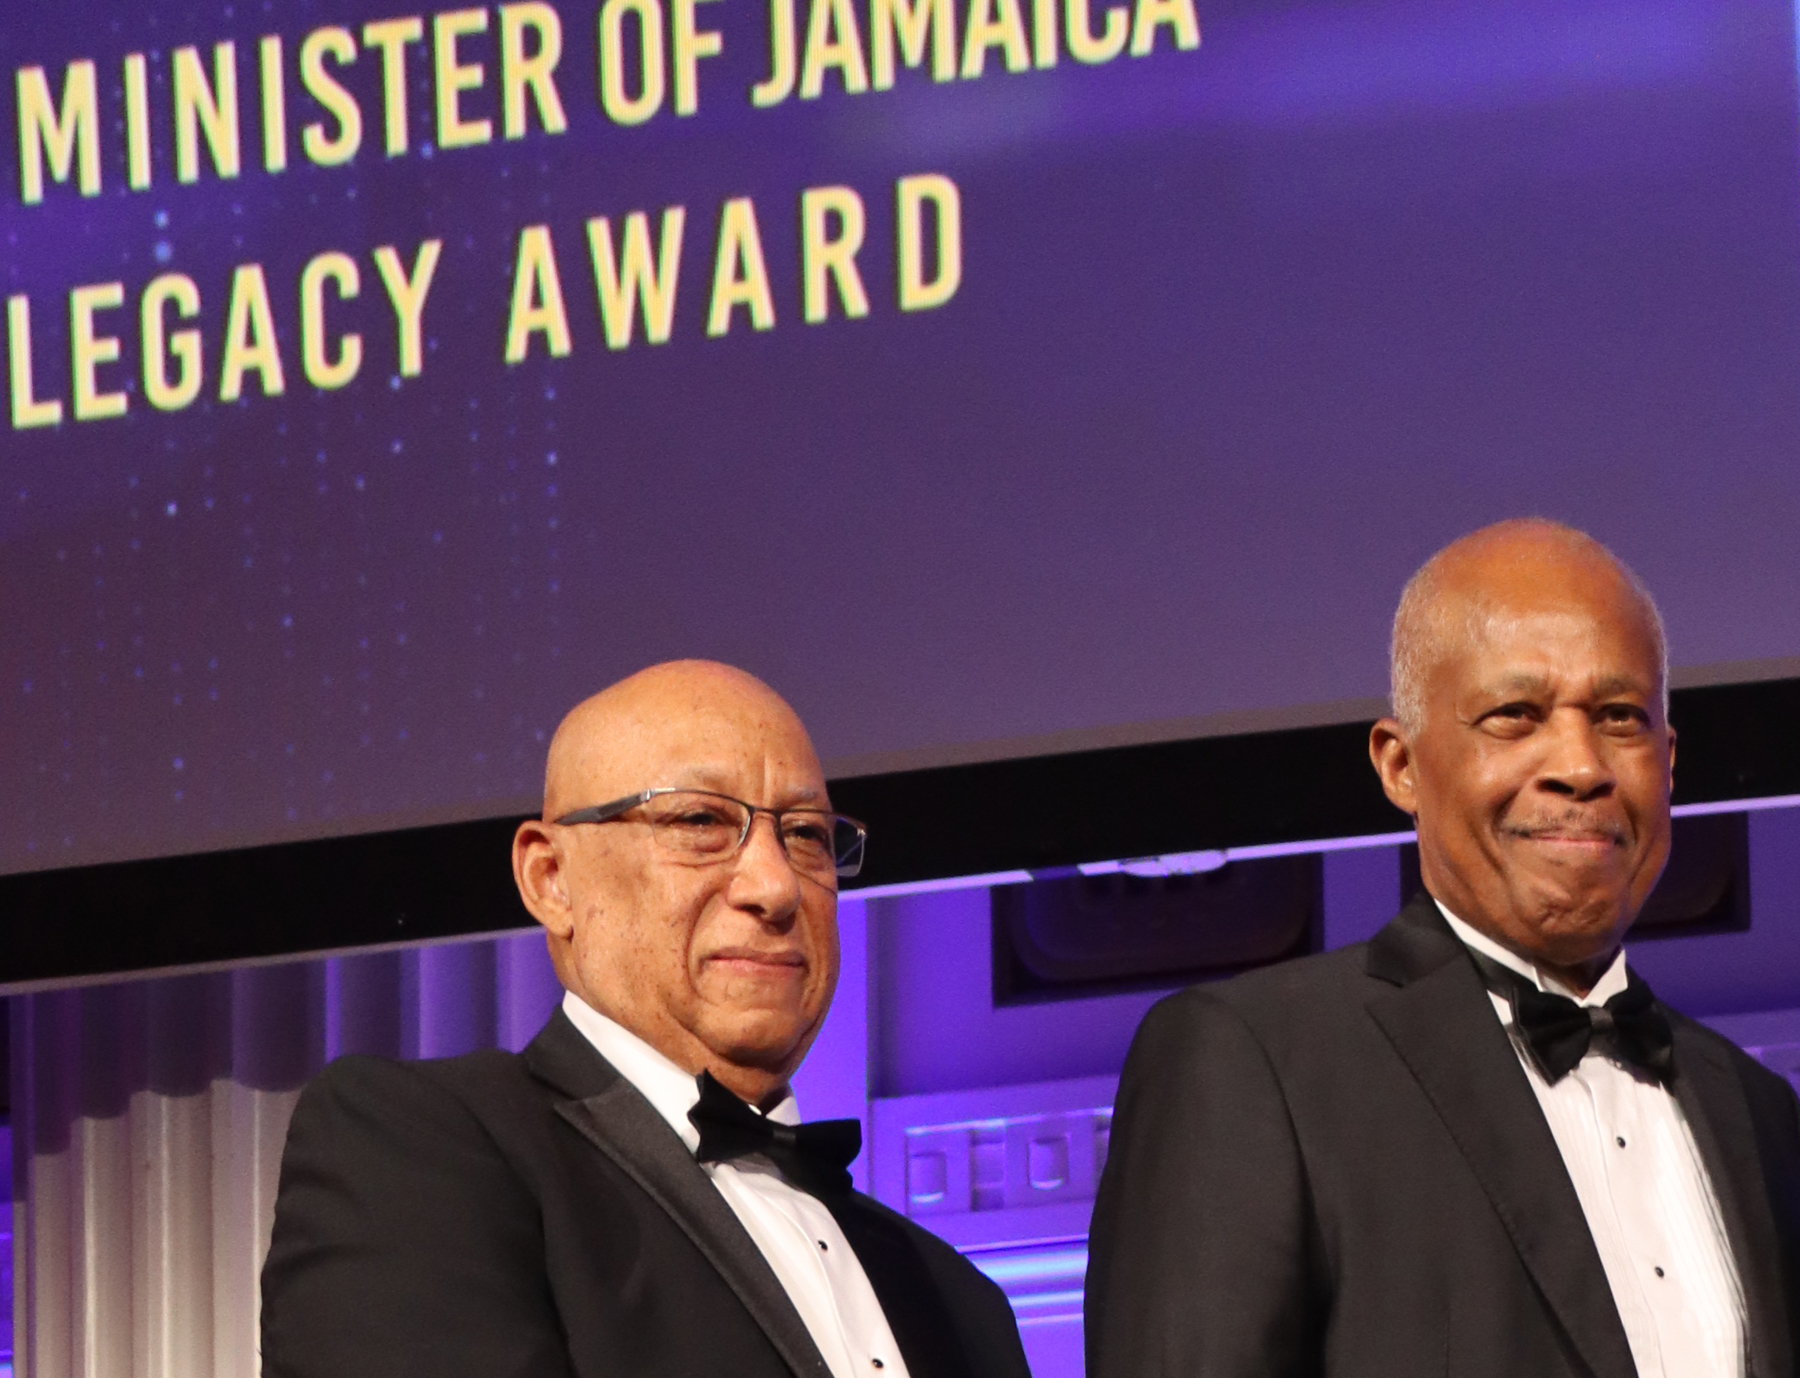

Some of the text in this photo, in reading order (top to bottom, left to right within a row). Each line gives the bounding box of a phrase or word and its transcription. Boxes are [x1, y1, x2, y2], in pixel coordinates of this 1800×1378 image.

[16, 2, 567, 203] MINISTER
[599, 0, 723, 126] OF
[8, 174, 962, 429] LEGACY AWARD
